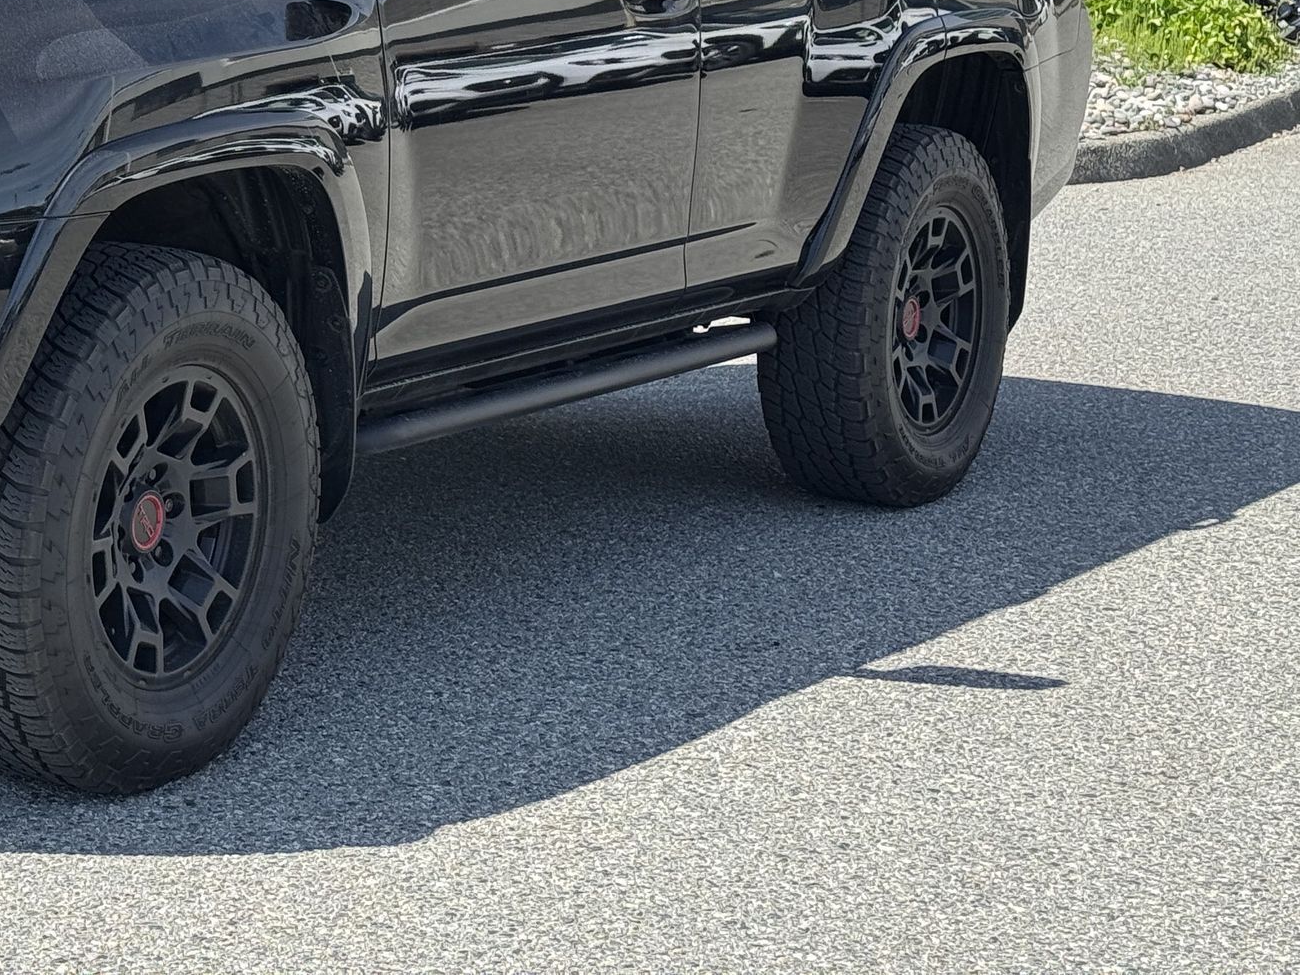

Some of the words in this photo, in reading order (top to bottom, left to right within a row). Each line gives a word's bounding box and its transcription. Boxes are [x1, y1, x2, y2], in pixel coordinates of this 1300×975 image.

[162, 320, 256, 351] TERRAIN
[137, 504, 155, 538] TRD
[83, 650, 184, 744] GRAPPLER
